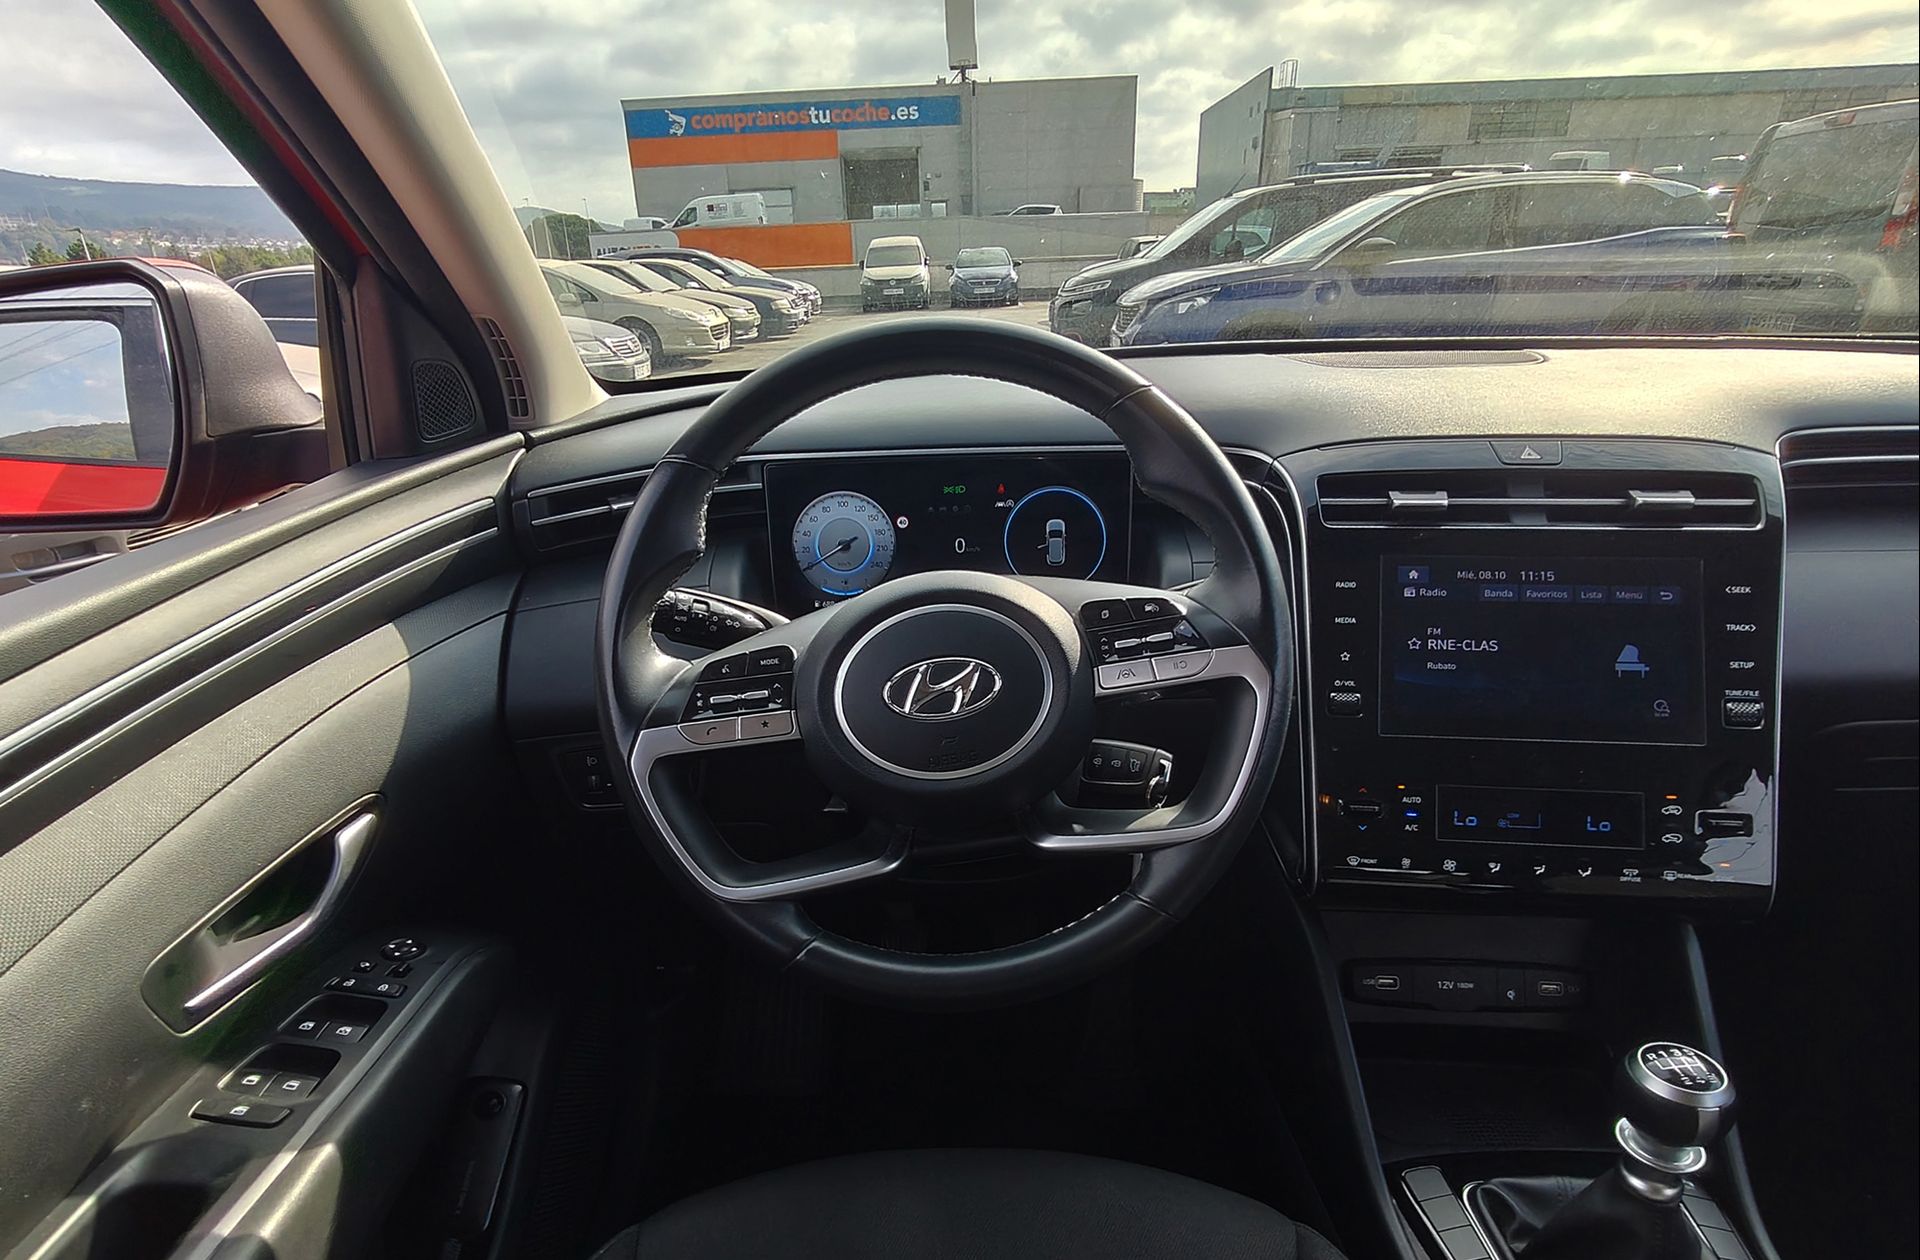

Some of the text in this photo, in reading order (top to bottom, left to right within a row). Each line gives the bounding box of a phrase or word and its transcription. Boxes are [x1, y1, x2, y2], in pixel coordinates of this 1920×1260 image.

[691, 101, 920, 132] compramostucoche.es
[837, 500, 849, 508] 100
[854, 505, 866, 513] 120
[867, 514, 879, 522] 150
[1479, 571, 1506, 580] 08.10
[1520, 571, 1555, 582] 11:15
[1419, 588, 1447, 597] Radio
[1484, 589, 1513, 598] Banda
[1526, 589, 1568, 599] Favoritos
[1581, 591, 1602, 599] Lista
[1427, 627, 1441, 636] FM
[1427, 639, 1498, 652] RNE-CLAS
[760, 657, 780, 665] MODE
[1729, 661, 1755, 669] SETUP
[1426, 662, 1457, 670] Rubato
[1453, 810, 1478, 826] Lo
[1586, 815, 1612, 832] Lo
[1404, 824, 1419, 832] A/C
[1437, 980, 1454, 989] 12V
